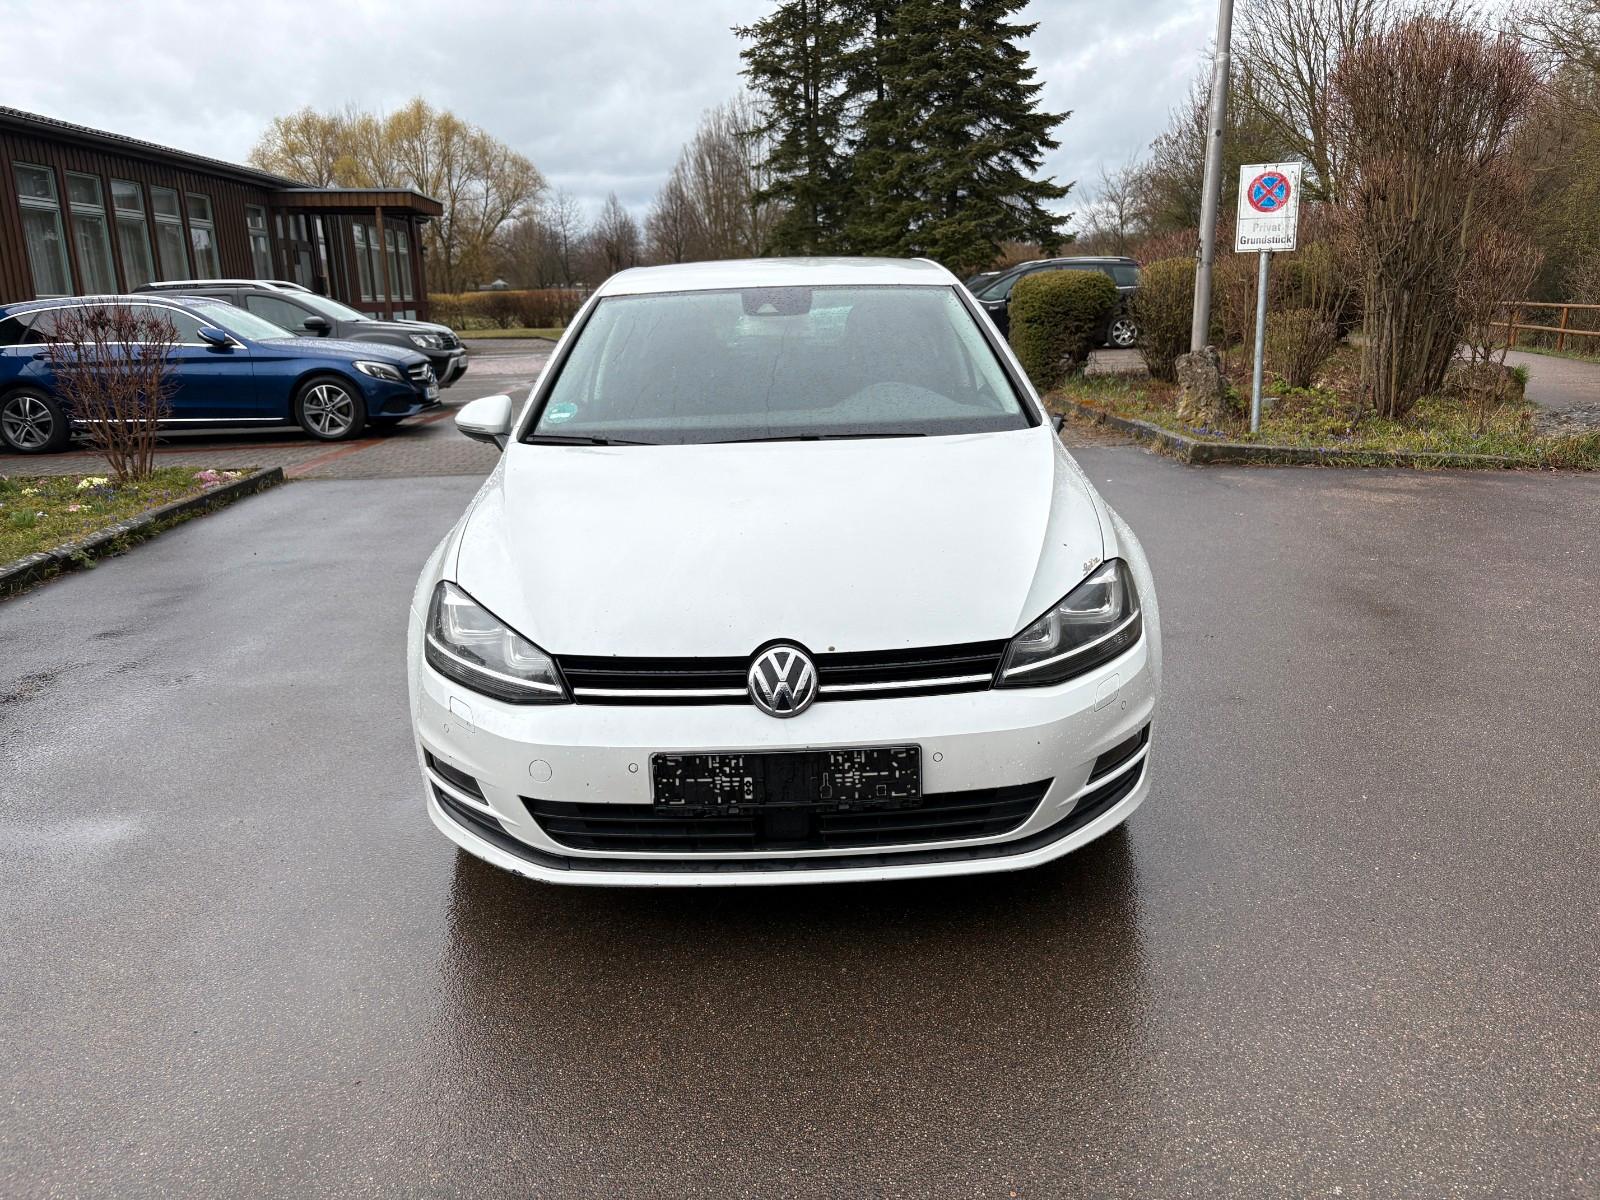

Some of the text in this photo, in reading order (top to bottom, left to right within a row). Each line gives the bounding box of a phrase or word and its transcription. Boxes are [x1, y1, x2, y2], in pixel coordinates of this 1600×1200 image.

[1252, 222, 1282, 232] Privat
[1240, 234, 1292, 245] Grundstück
[750, 647, 815, 712] VW
